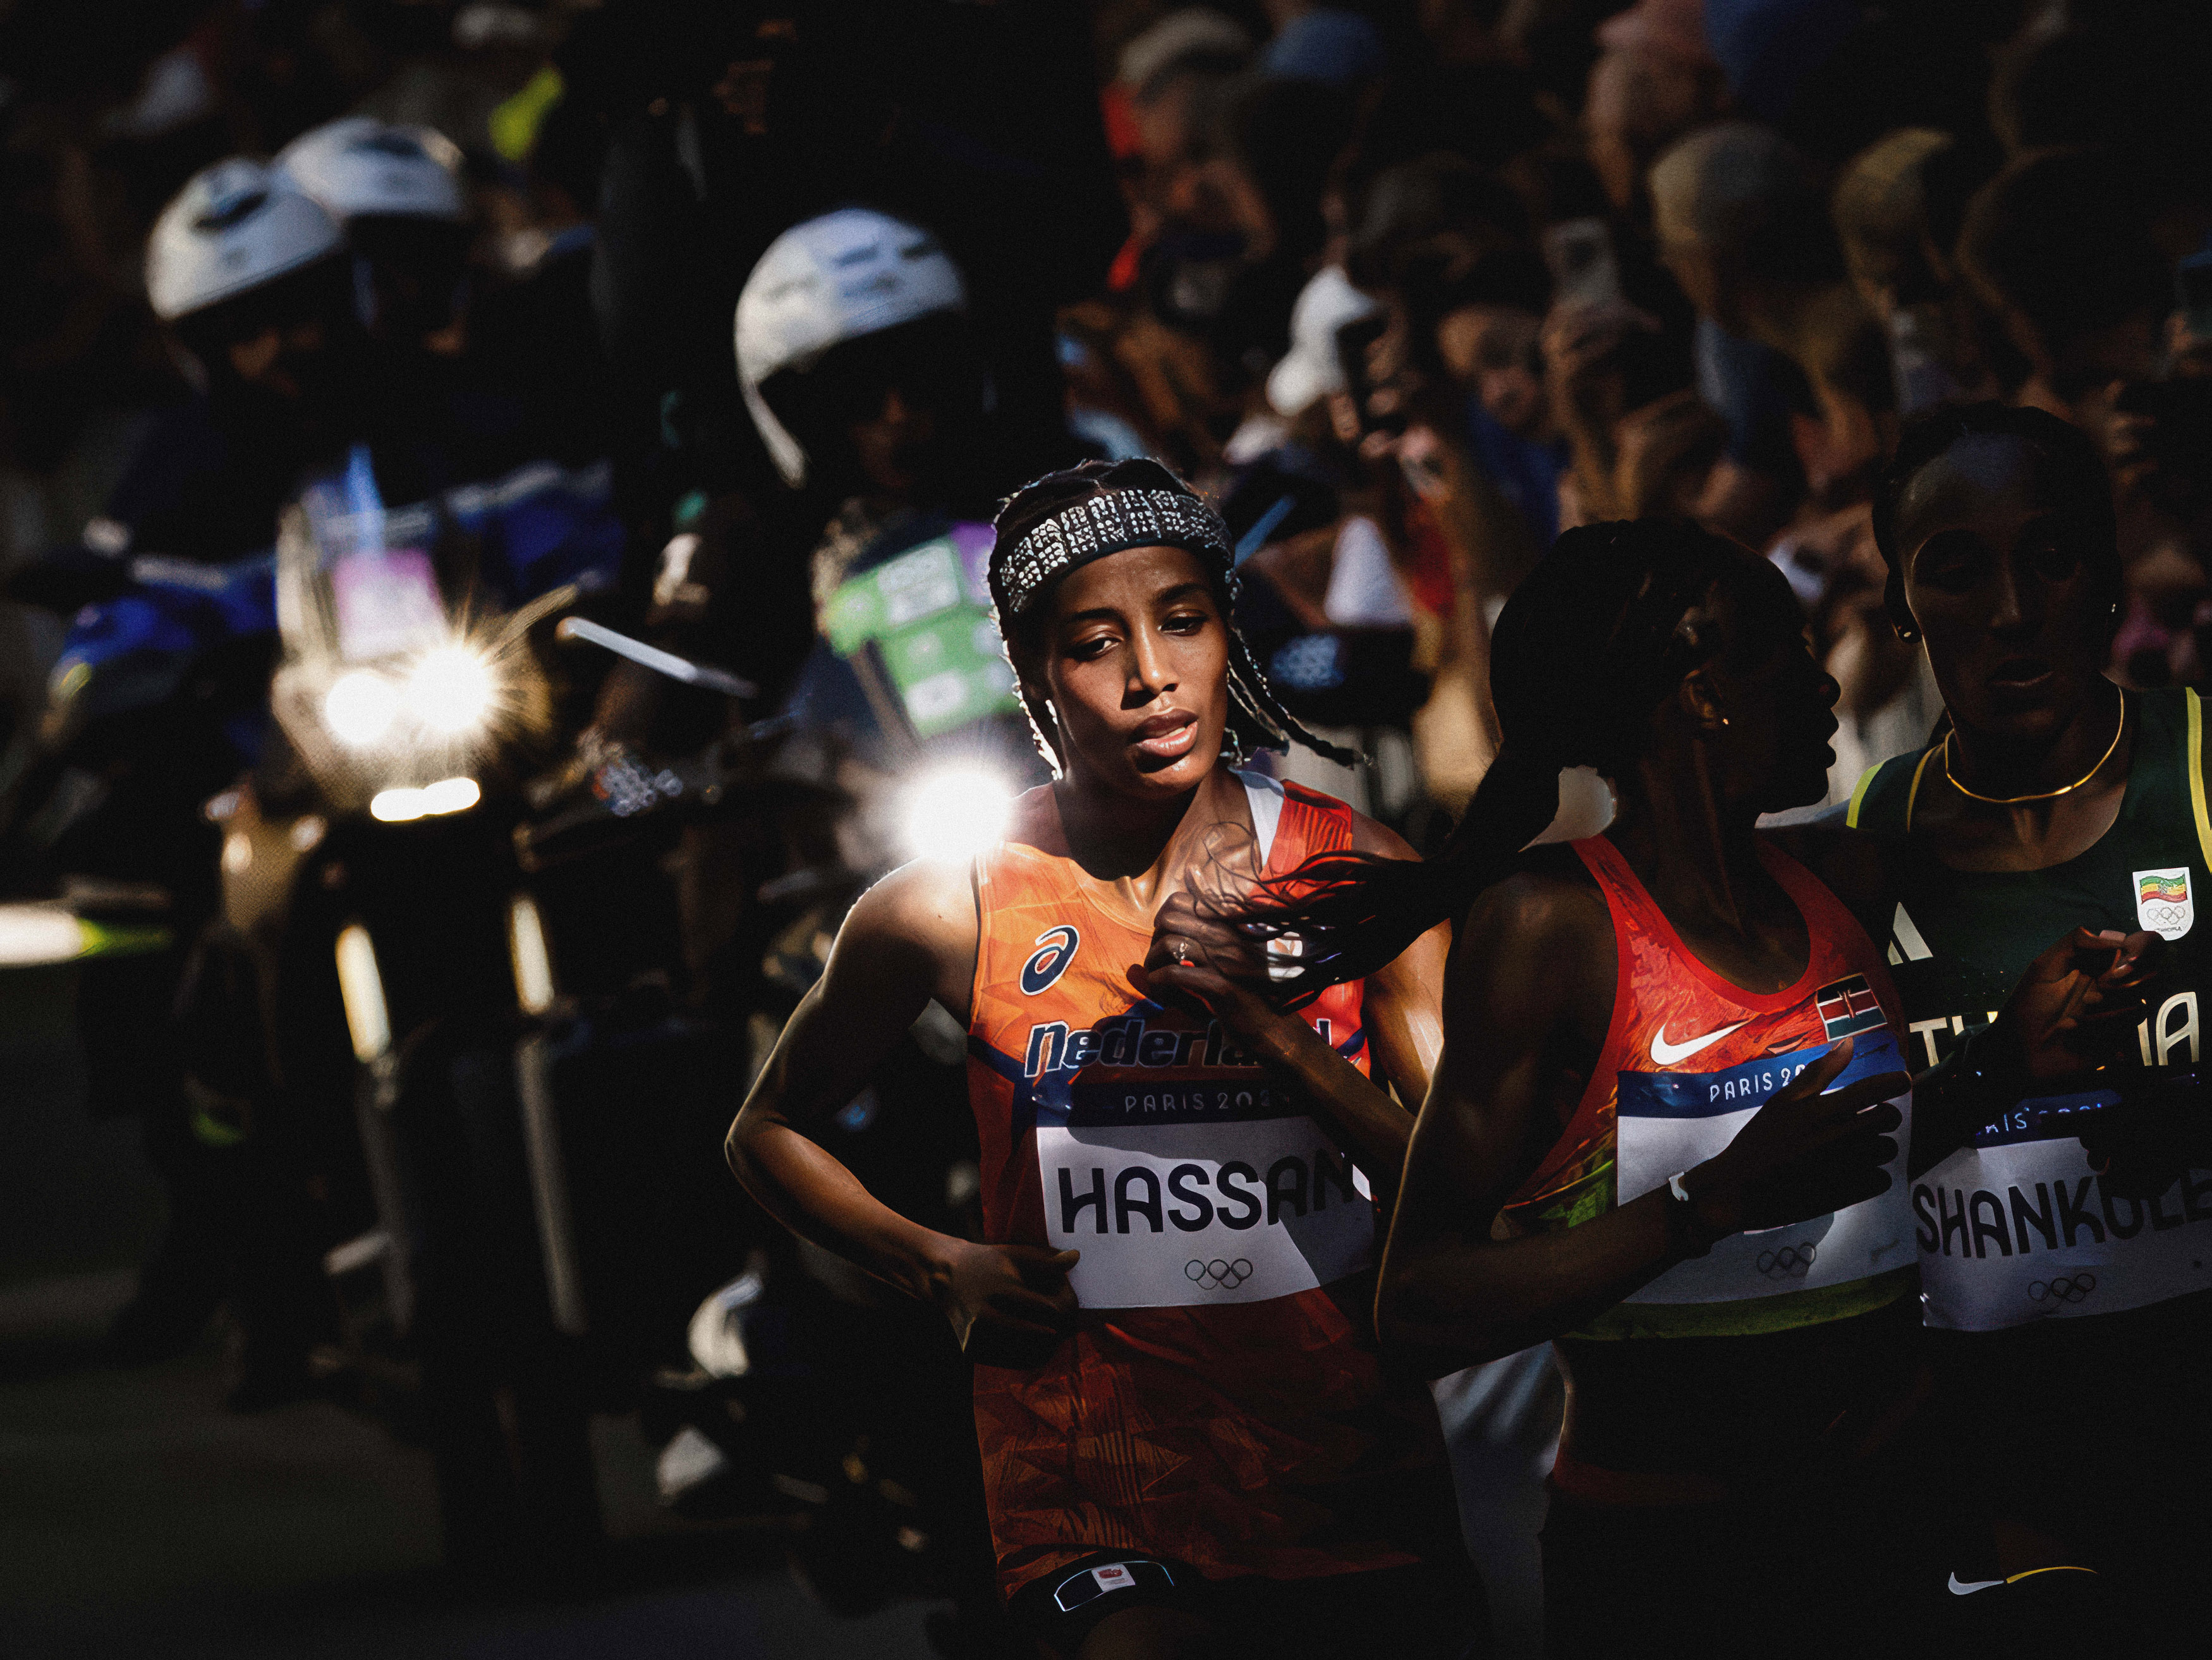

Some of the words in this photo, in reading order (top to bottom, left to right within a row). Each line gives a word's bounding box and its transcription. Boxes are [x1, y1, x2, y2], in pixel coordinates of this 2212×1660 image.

[1709, 1072, 1773, 1102] PARIS
[1124, 1092, 1204, 1113] PARIS
[1057, 1149, 1354, 1233] HASSAN
